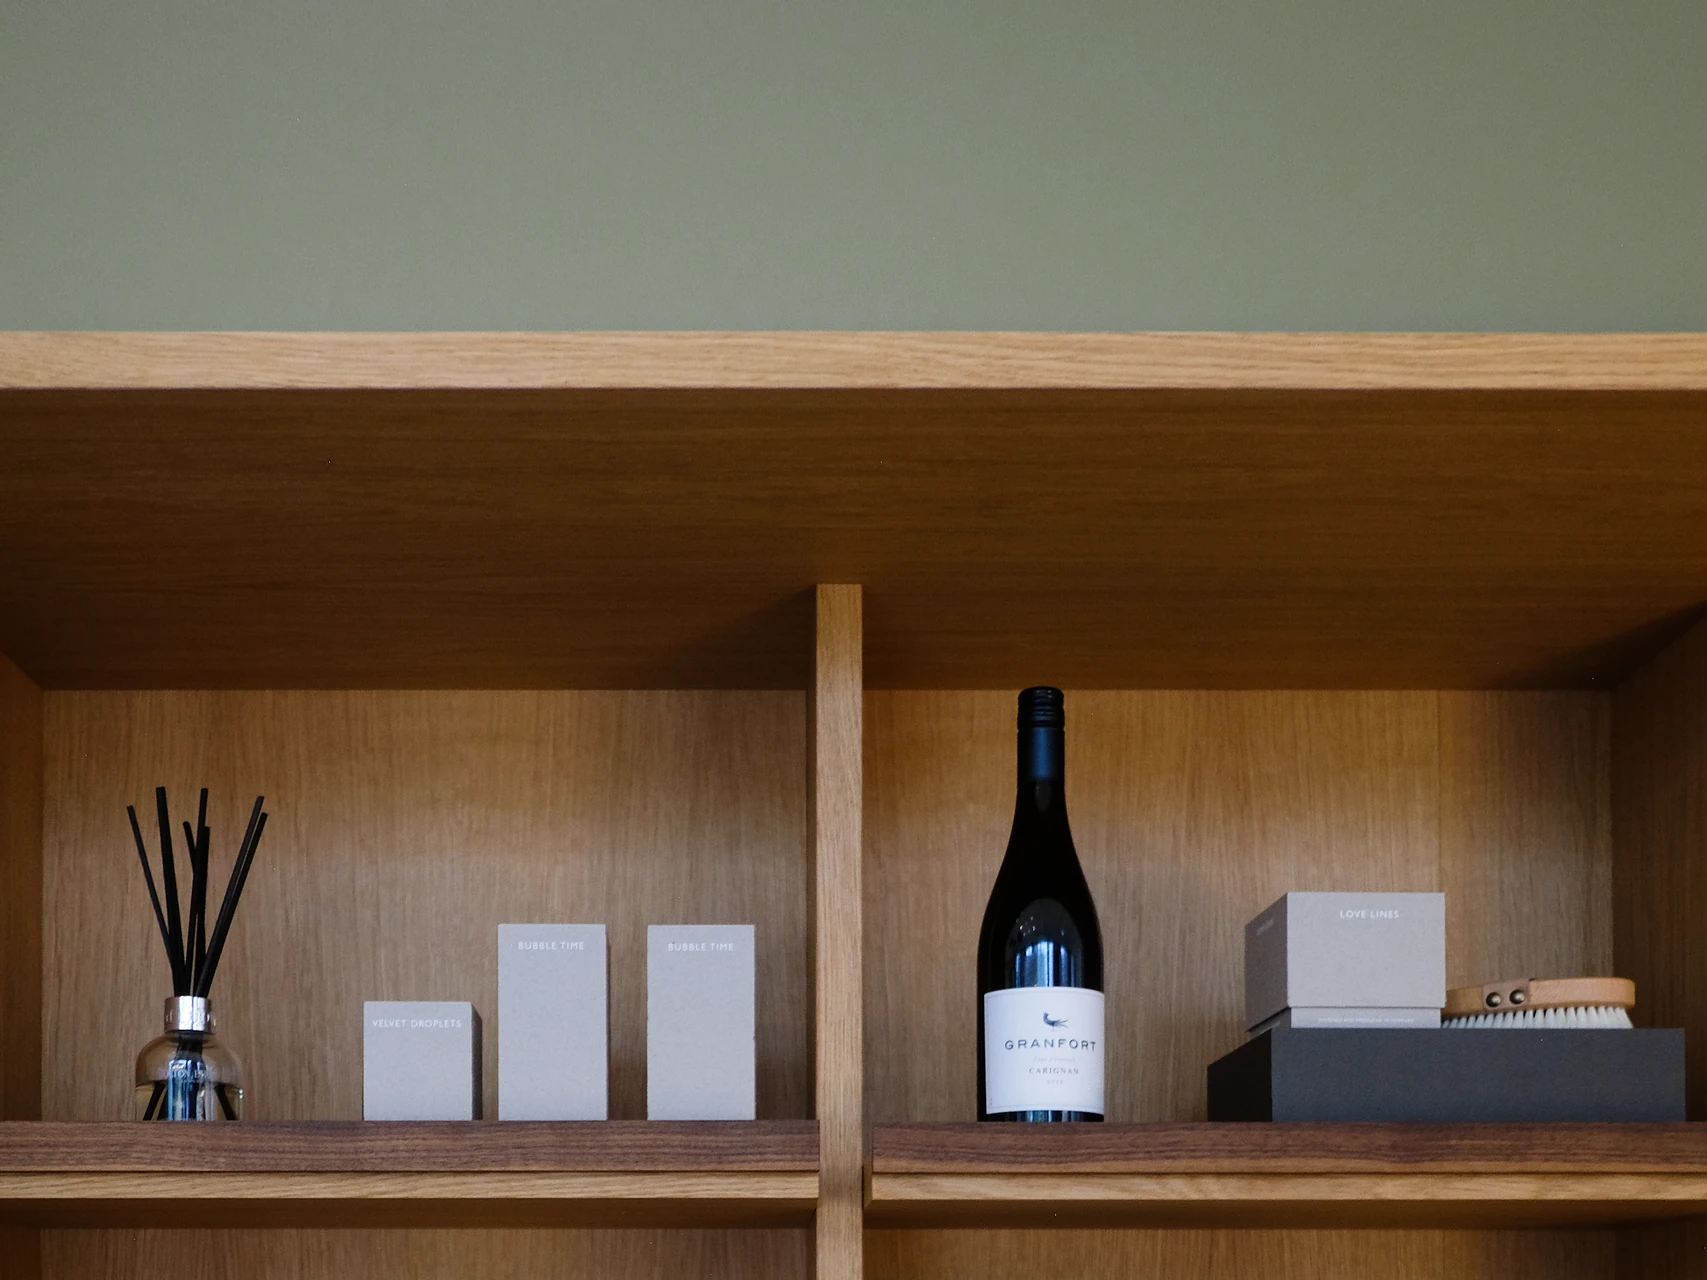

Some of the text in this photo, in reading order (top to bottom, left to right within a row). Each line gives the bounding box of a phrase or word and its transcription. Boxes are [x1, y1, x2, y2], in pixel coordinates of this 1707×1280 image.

[1339, 910, 1399, 919] LOVE LINES
[518, 941, 584, 950] BUBBLE TIME
[667, 942, 734, 952] BUBBLE TIME
[372, 1019, 462, 1028] VELVET DROPLETS
[1004, 1039, 1097, 1051] GRANFORT
[1028, 1067, 1079, 1075] CARIGNAN
